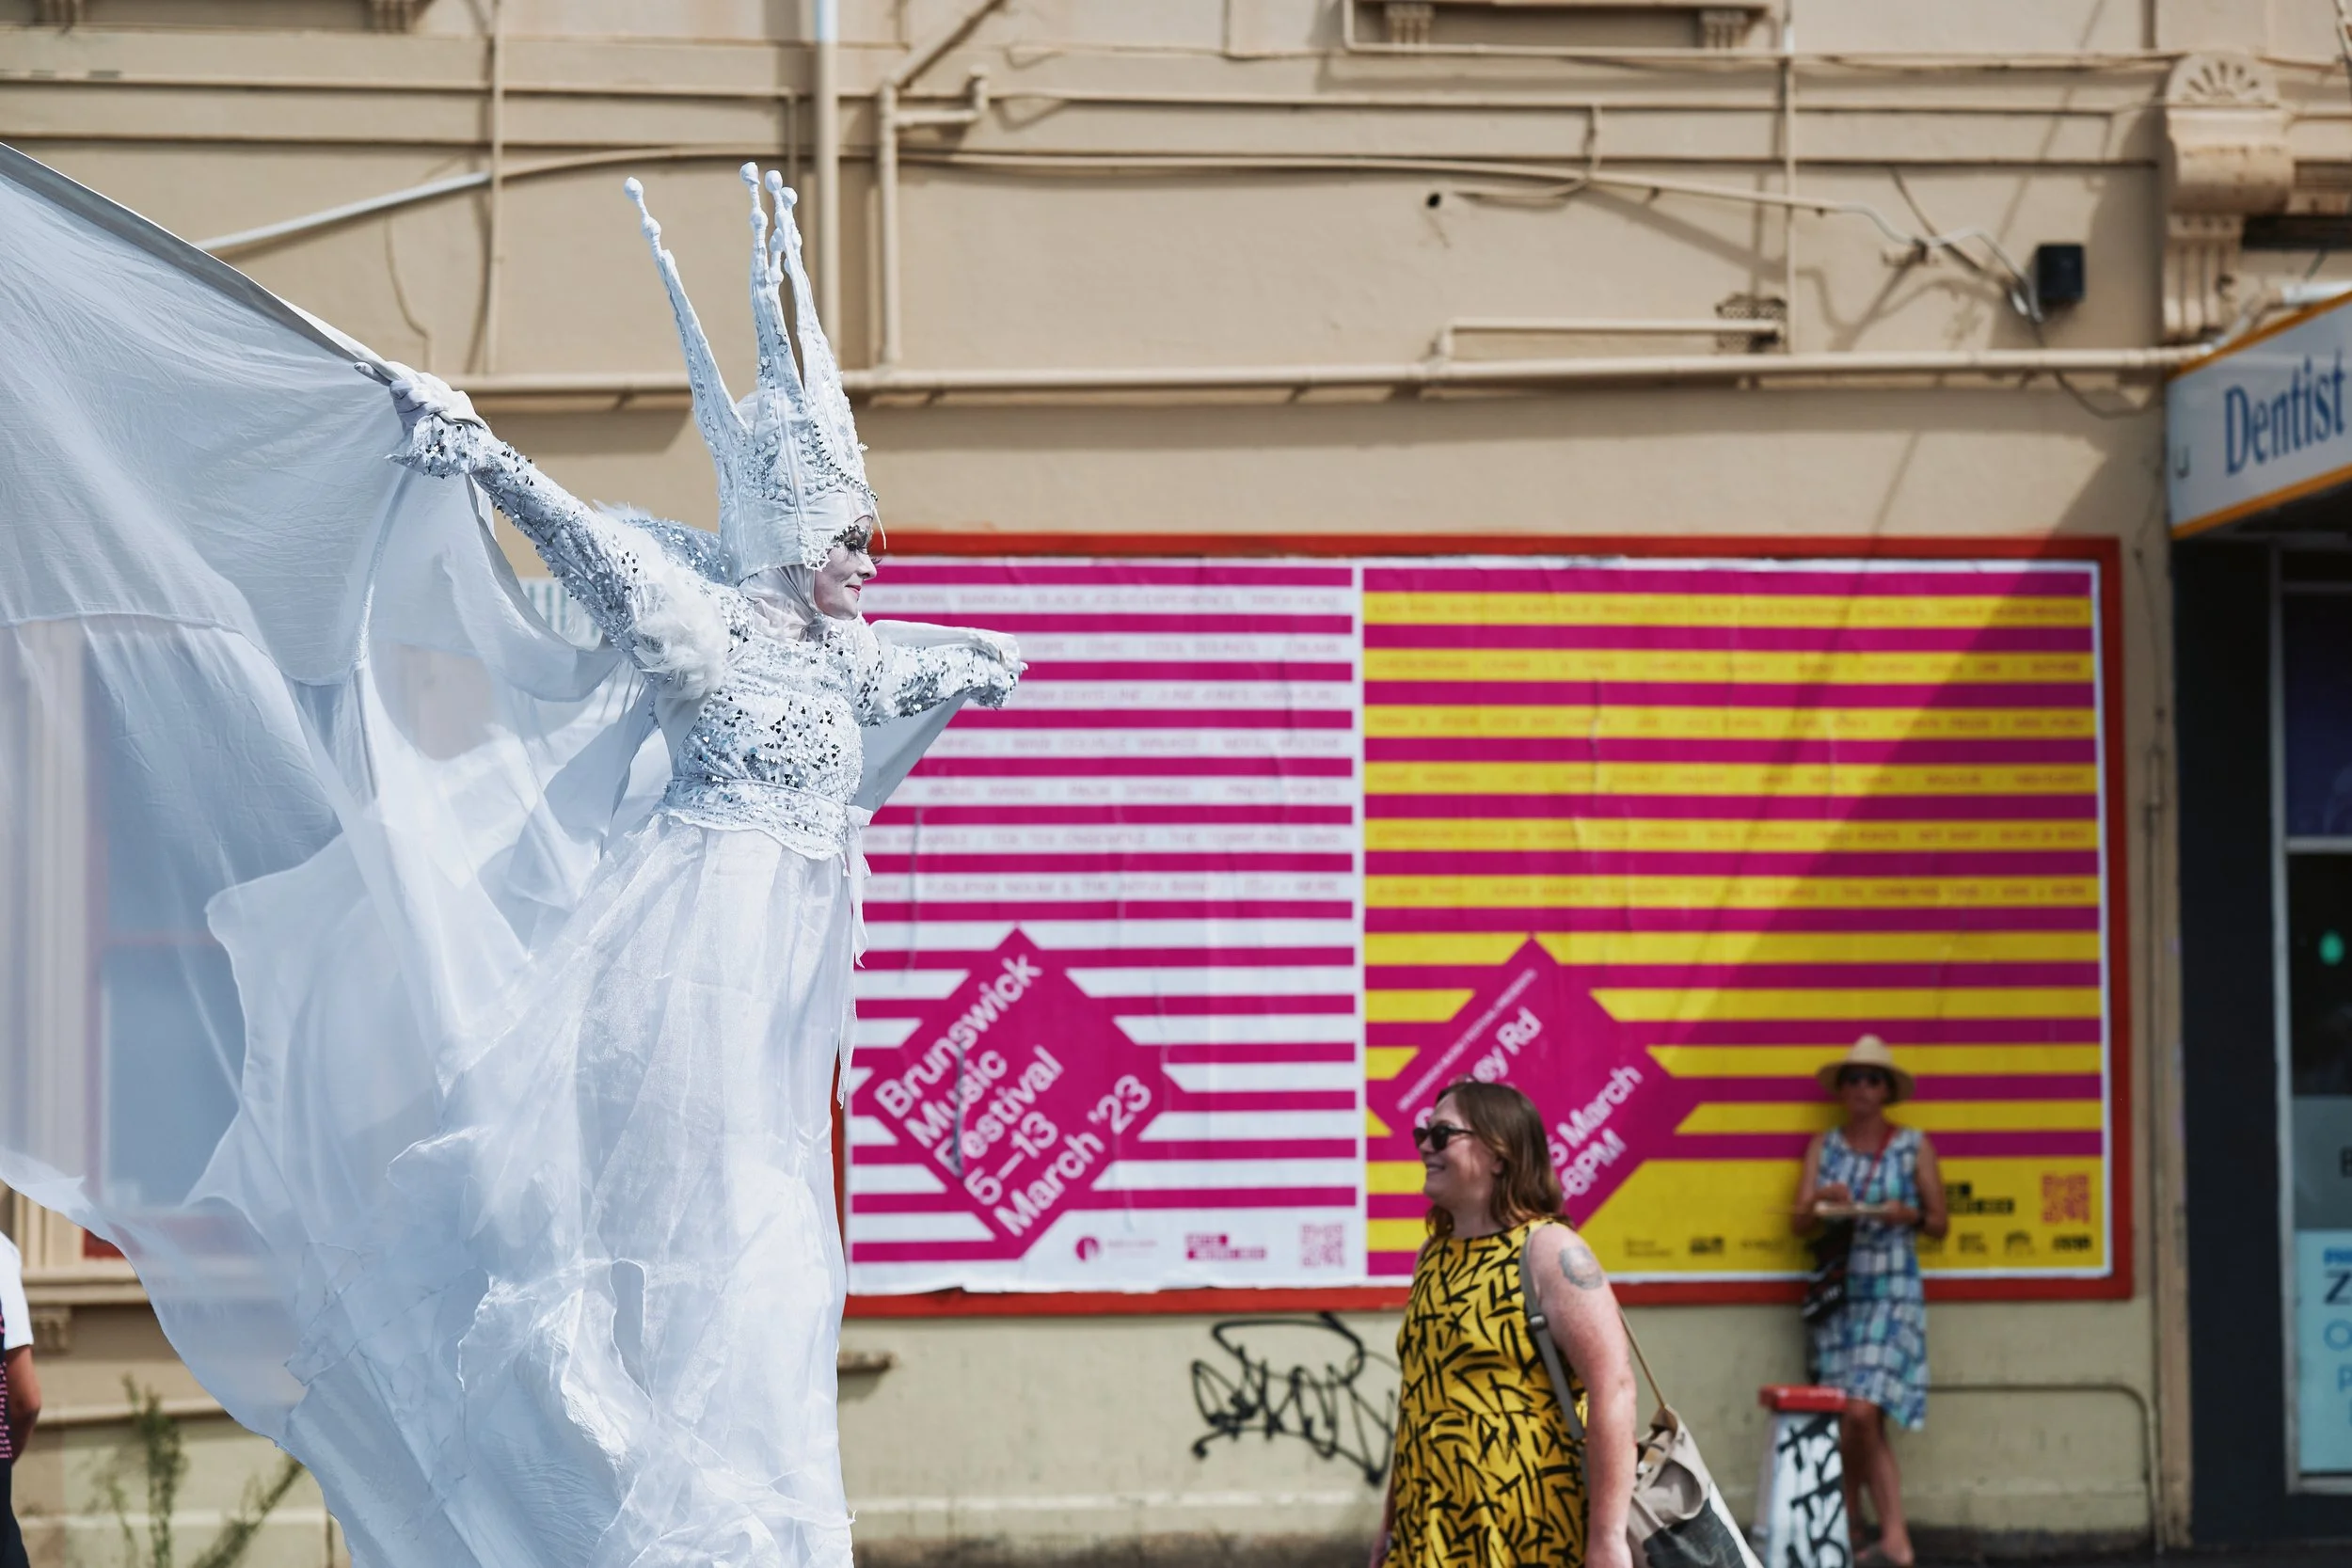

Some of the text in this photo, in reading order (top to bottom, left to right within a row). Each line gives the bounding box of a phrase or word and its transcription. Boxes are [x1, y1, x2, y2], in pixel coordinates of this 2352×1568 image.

[2224, 349, 2345, 477] Dentist
[874, 954, 1042, 1118] Brunswick
[1496, 1006, 1543, 1056] Rd
[904, 1050, 1008, 1148] Music
[1556, 1066, 1644, 1149] March
[993, 1132, 1105, 1237] March
